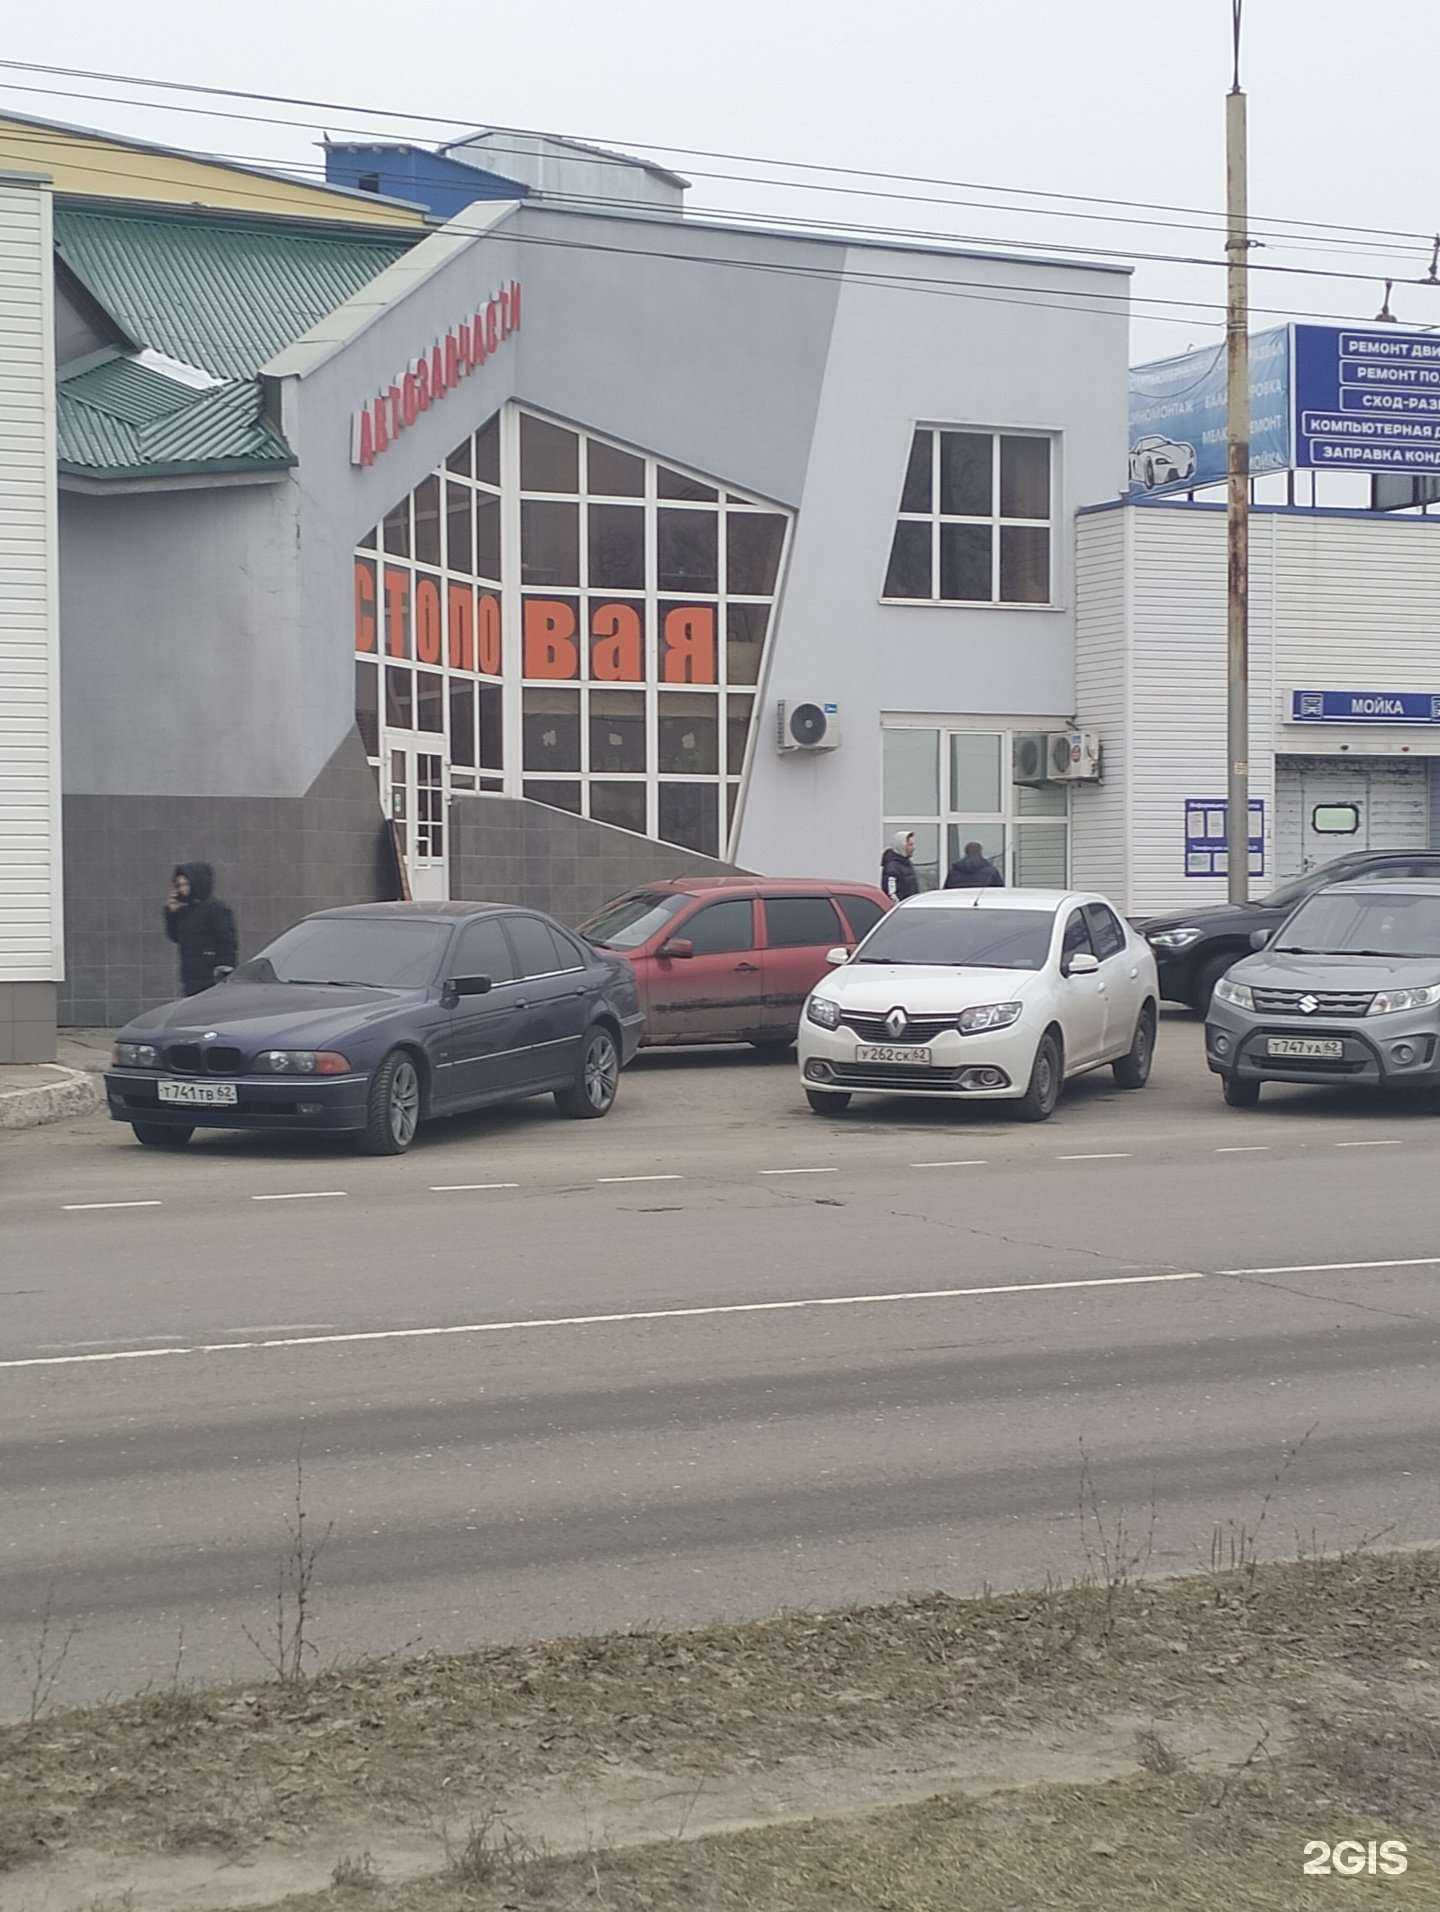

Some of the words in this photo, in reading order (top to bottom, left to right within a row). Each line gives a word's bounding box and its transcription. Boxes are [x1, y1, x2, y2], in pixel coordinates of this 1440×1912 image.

[1349, 341, 1409, 355] РЕМОНТ
[354, 280, 521, 466] АВТОЗАПЧАСТИ
[1357, 367, 1418, 381] РЕМОНТ
[1420, 370, 1440, 384] ПО
[1311, 419, 1432, 436] КОМПЬЮТЕРНАЯ
[1323, 446, 1403, 461] ЗАПРАВКА
[1351, 697, 1404, 714] МОЙКА
